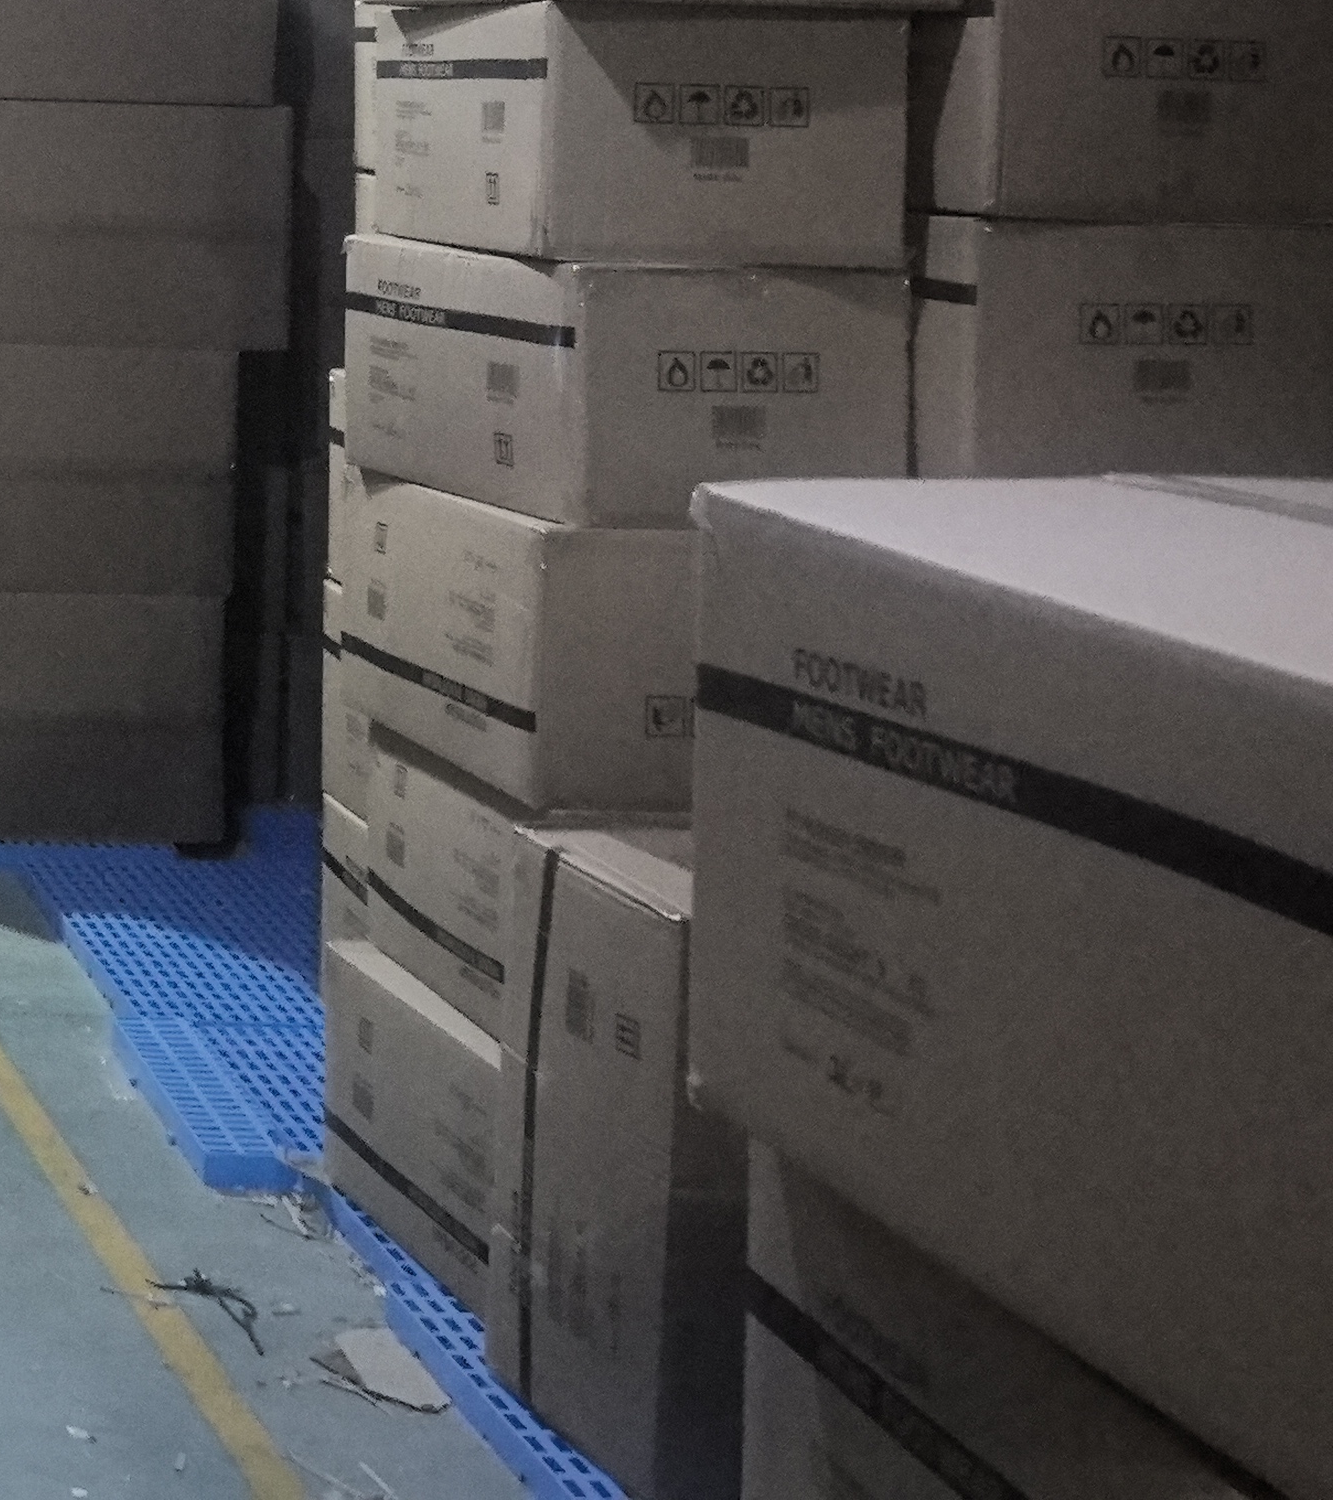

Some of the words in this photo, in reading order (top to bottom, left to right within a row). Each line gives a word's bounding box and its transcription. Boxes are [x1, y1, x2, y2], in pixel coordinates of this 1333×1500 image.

[377, 278, 422, 300] FOOTWEAR
[399, 304, 446, 325] FOOTWEAR
[793, 648, 928, 718] FOOTWEAR
[789, 700, 858, 752] MENS
[870, 726, 1019, 802] FOOTWEAR
